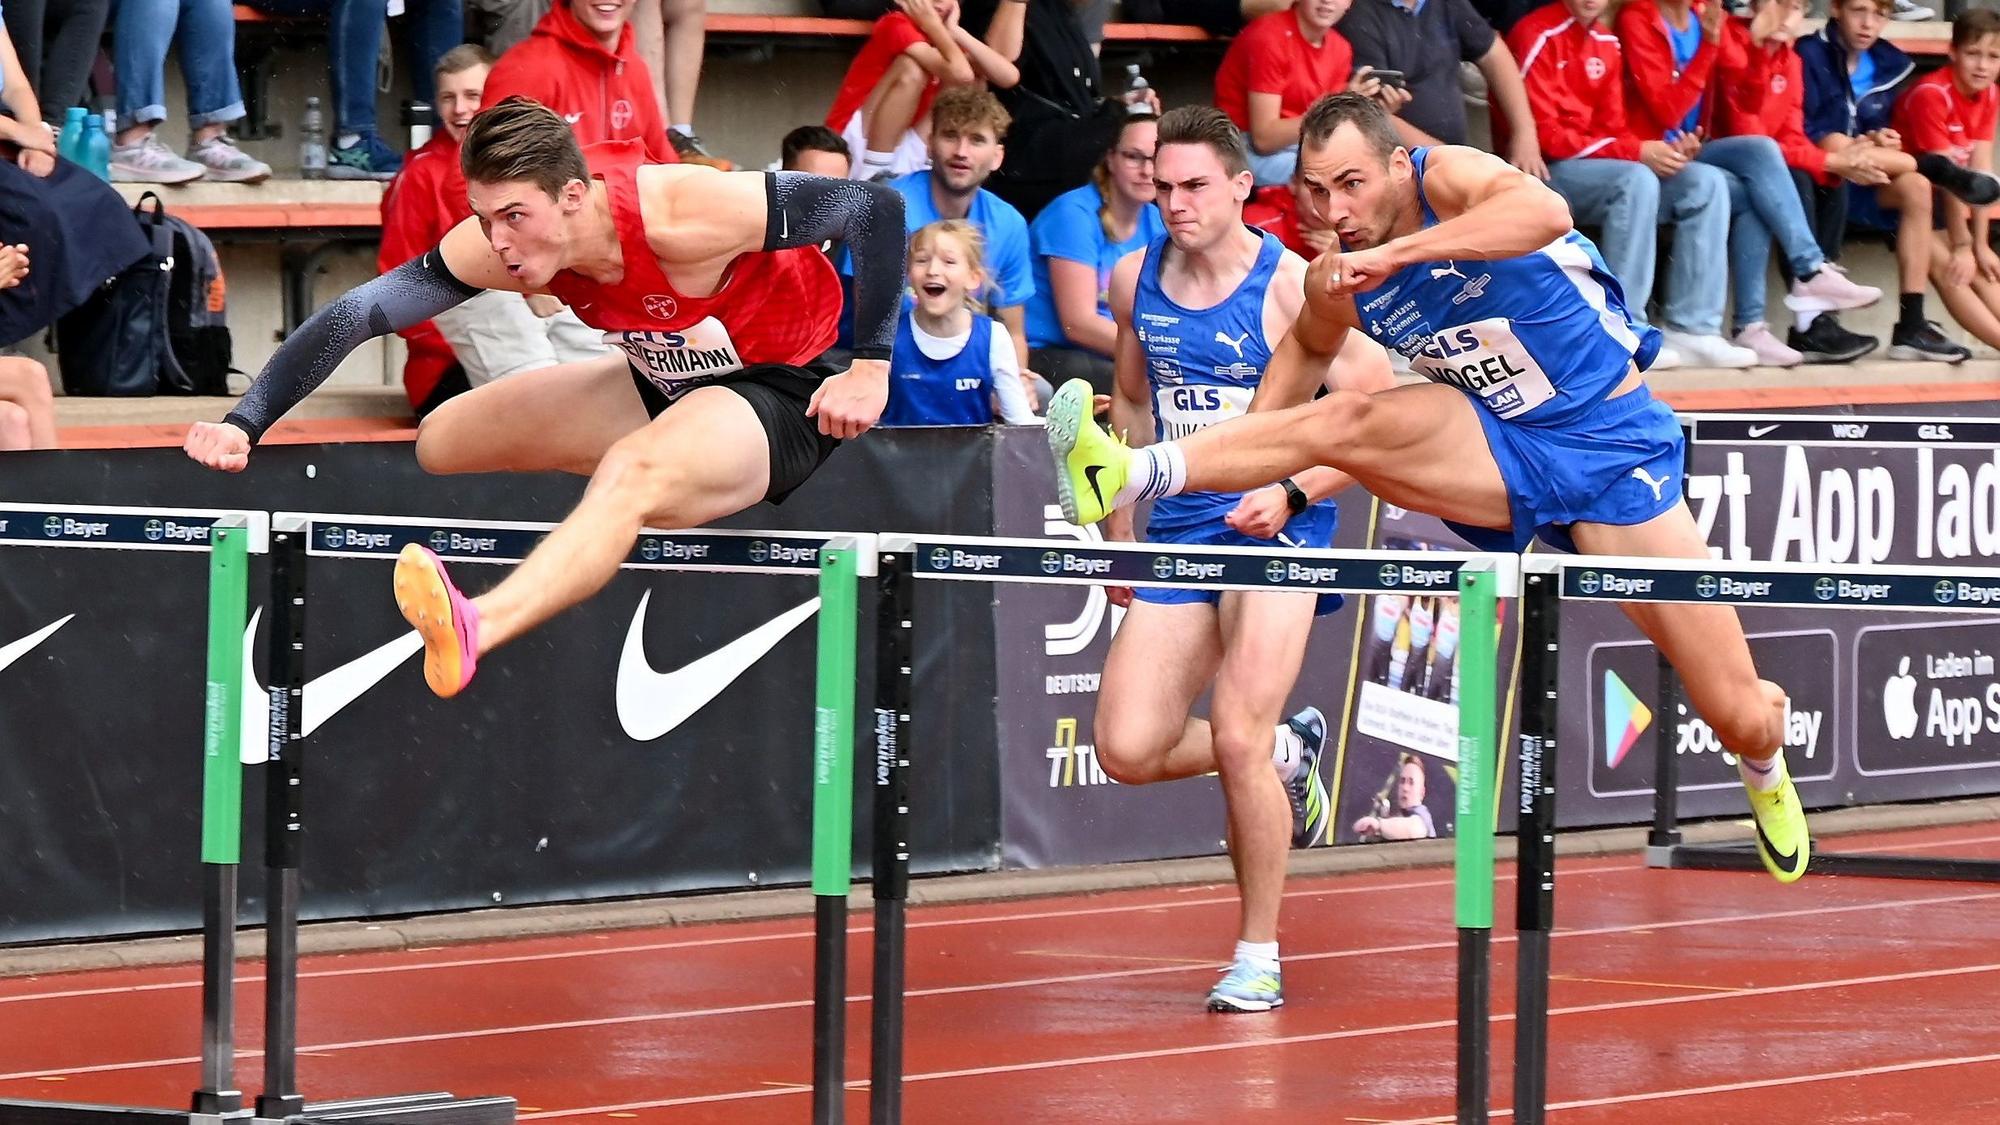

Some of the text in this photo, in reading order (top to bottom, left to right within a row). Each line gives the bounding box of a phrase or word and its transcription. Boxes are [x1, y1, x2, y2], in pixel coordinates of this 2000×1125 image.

[1381, 299, 1417, 328] Sparkasse
[1388, 310, 1422, 337] Chemnitz
[1147, 334, 1181, 345] Sparkasse
[1425, 354, 1526, 392] VOGEL
[1486, 388, 1519, 409] LAN
[1831, 424, 1870, 439] WGV
[1770, 445, 1896, 565] App
[63, 519, 210, 542] Bayer Bayer
[345, 529, 818, 563] Bayer Bayer Bayer Bayer
[952, 550, 1452, 587] Bayer Bayer Bayer Bayer Bayer
[1601, 573, 1655, 595] Bayer
[1719, 576, 1772, 599] Bayer
[1837, 579, 1891, 602] Bayer
[1926, 649, 1995, 679] Laden in
[267, 685, 281, 761] vennekel
[1782, 696, 1823, 759] lay
[1926, 688, 1983, 747] App
[873, 707, 890, 786] vennekel
[1519, 733, 1534, 814] vennekel
